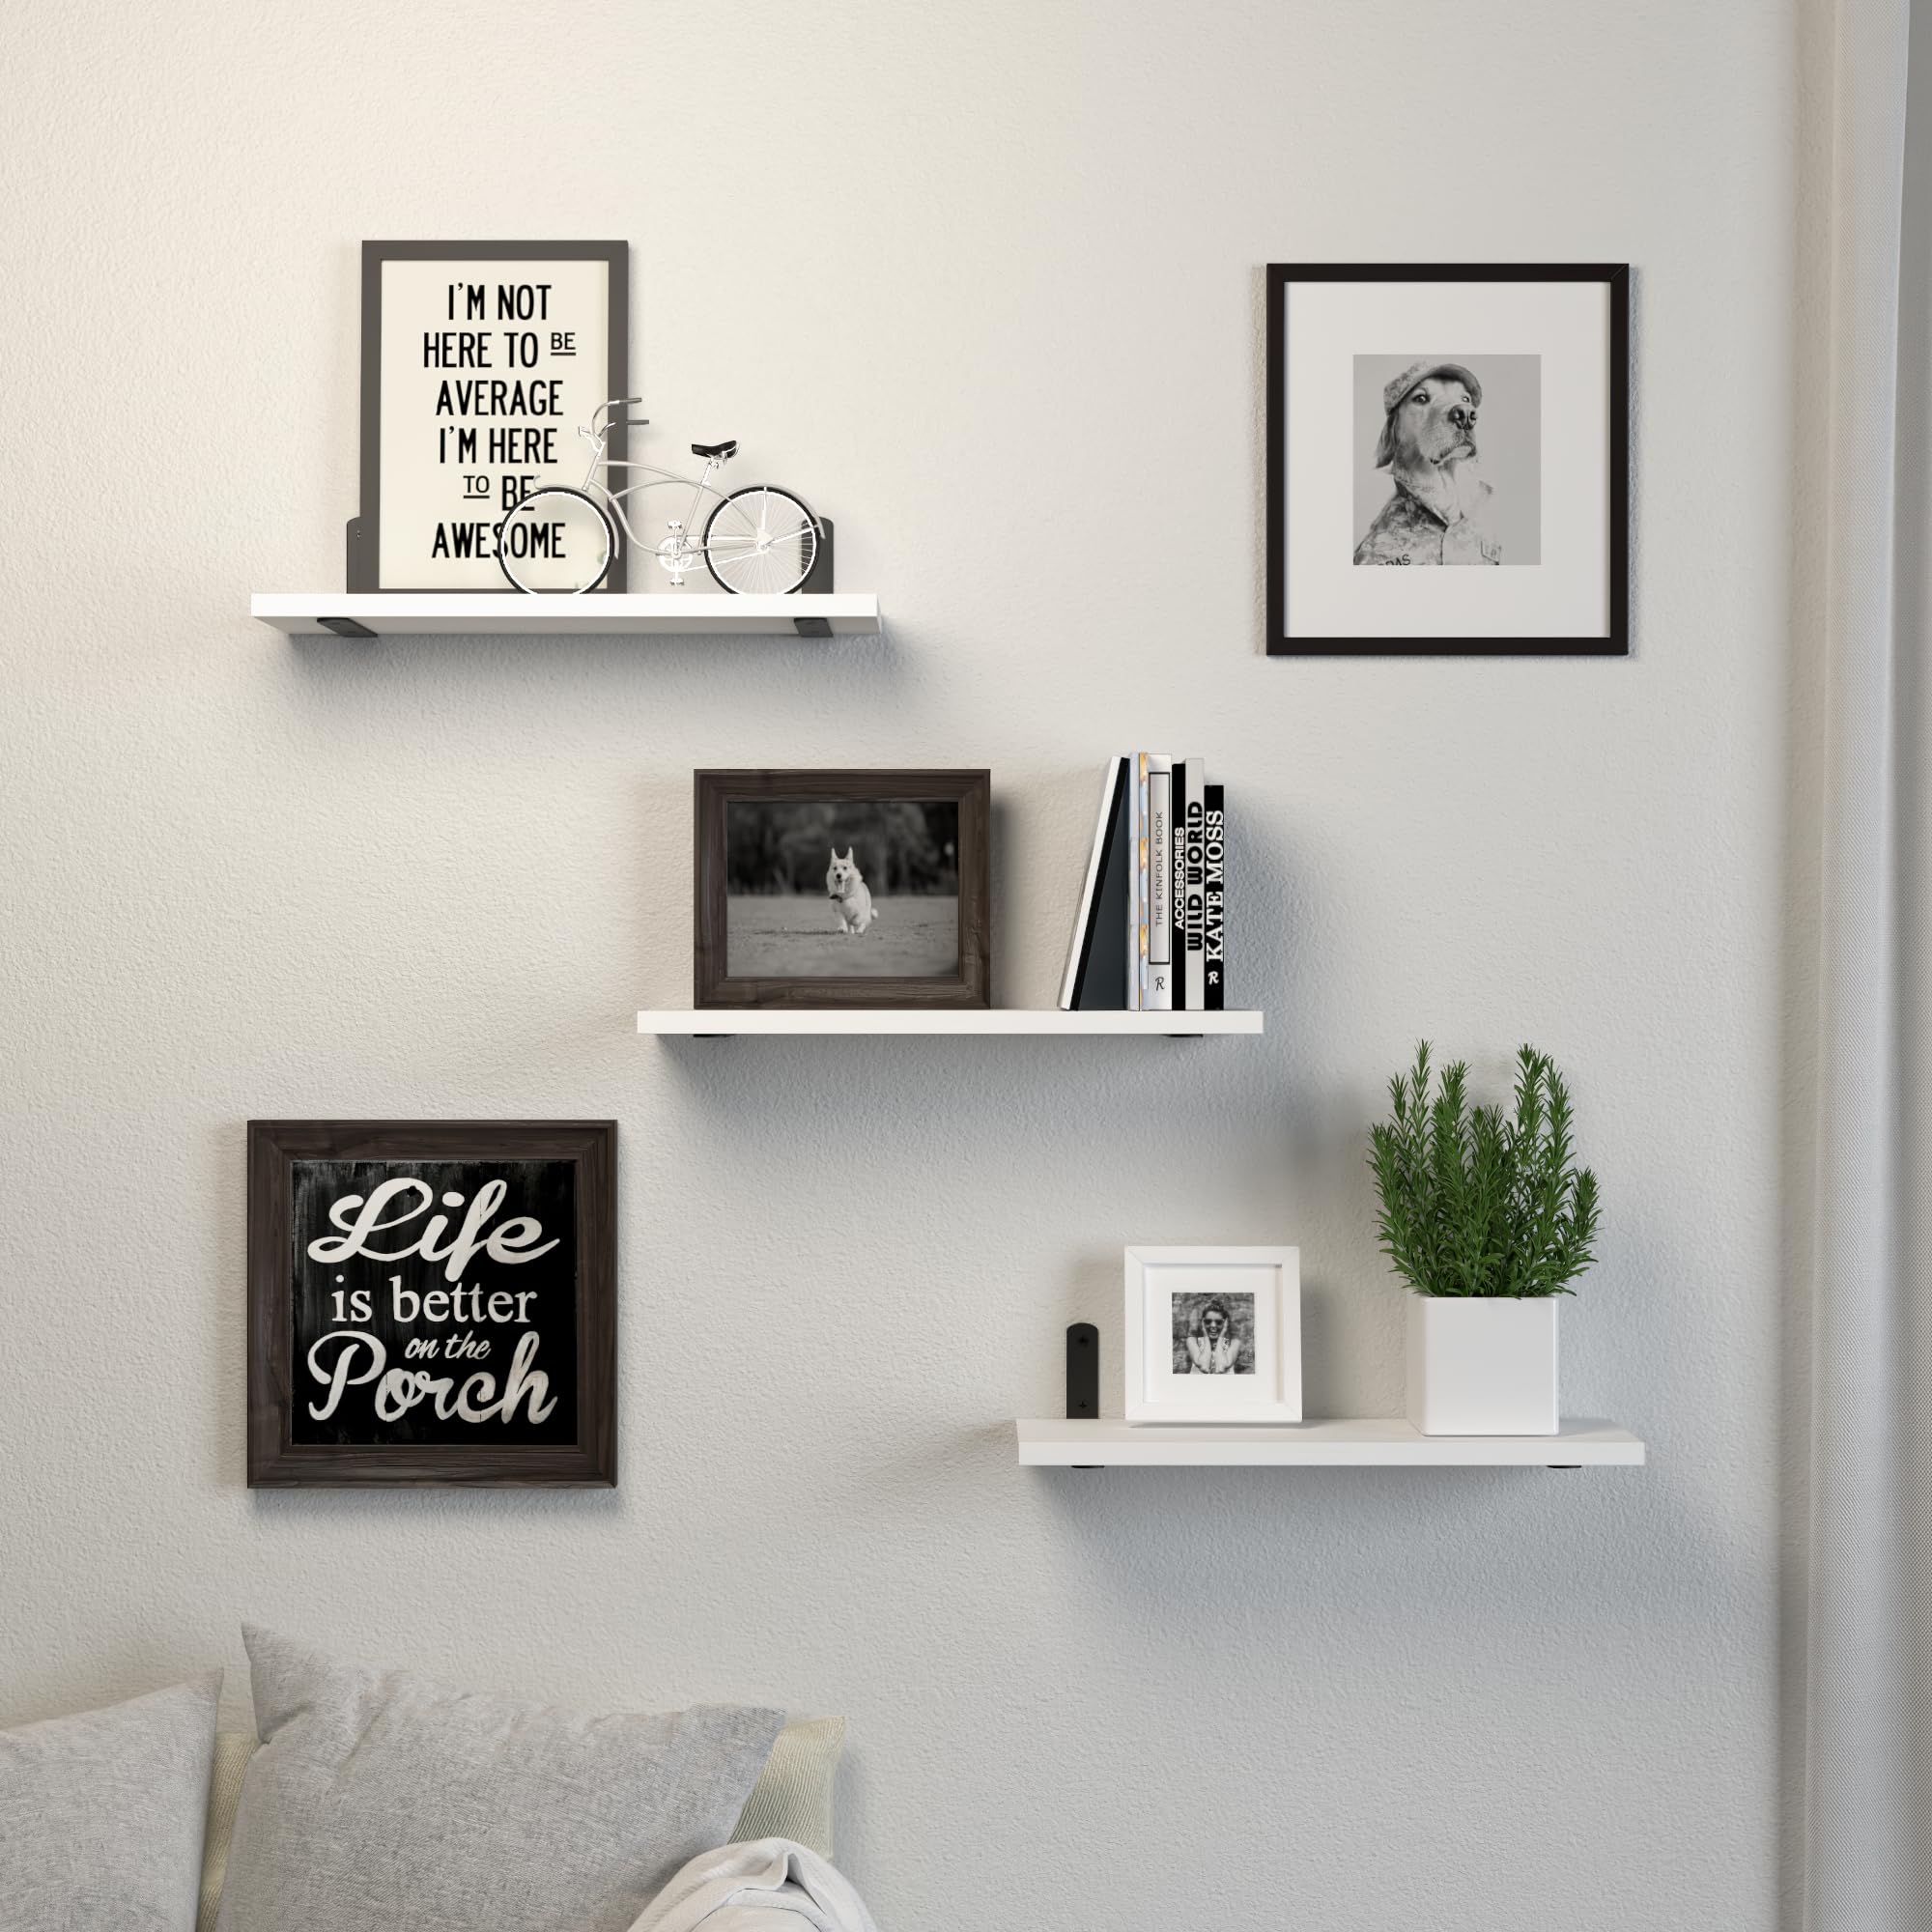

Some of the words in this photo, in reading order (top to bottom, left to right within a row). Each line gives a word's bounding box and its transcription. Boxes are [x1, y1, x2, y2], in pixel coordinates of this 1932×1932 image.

[448, 282, 486, 321] I'M
[497, 284, 552, 321] NOT
[423, 331, 493, 368] HERE
[503, 331, 539, 368] TO
[551, 331, 577, 351] BE
[436, 380, 564, 416] AVERAGE
[440, 425, 477, 464] I'M
[489, 428, 558, 464] HERE
[463, 475, 491, 494] TO
[501, 475, 535, 511] BE
[431, 523, 566, 558] AWESOME
[1206, 810, 1224, 885] MOSS
[1174, 827, 1185, 929] ACCESSORIES
[1206, 891, 1224, 963] KATE
[307, 1177, 560, 1282] Life
[331, 1274, 373, 1322] is
[388, 1275, 538, 1323] better
[404, 1337, 440, 1360] on
[444, 1329, 492, 1360] the
[307, 1330, 558, 1425] Porch
